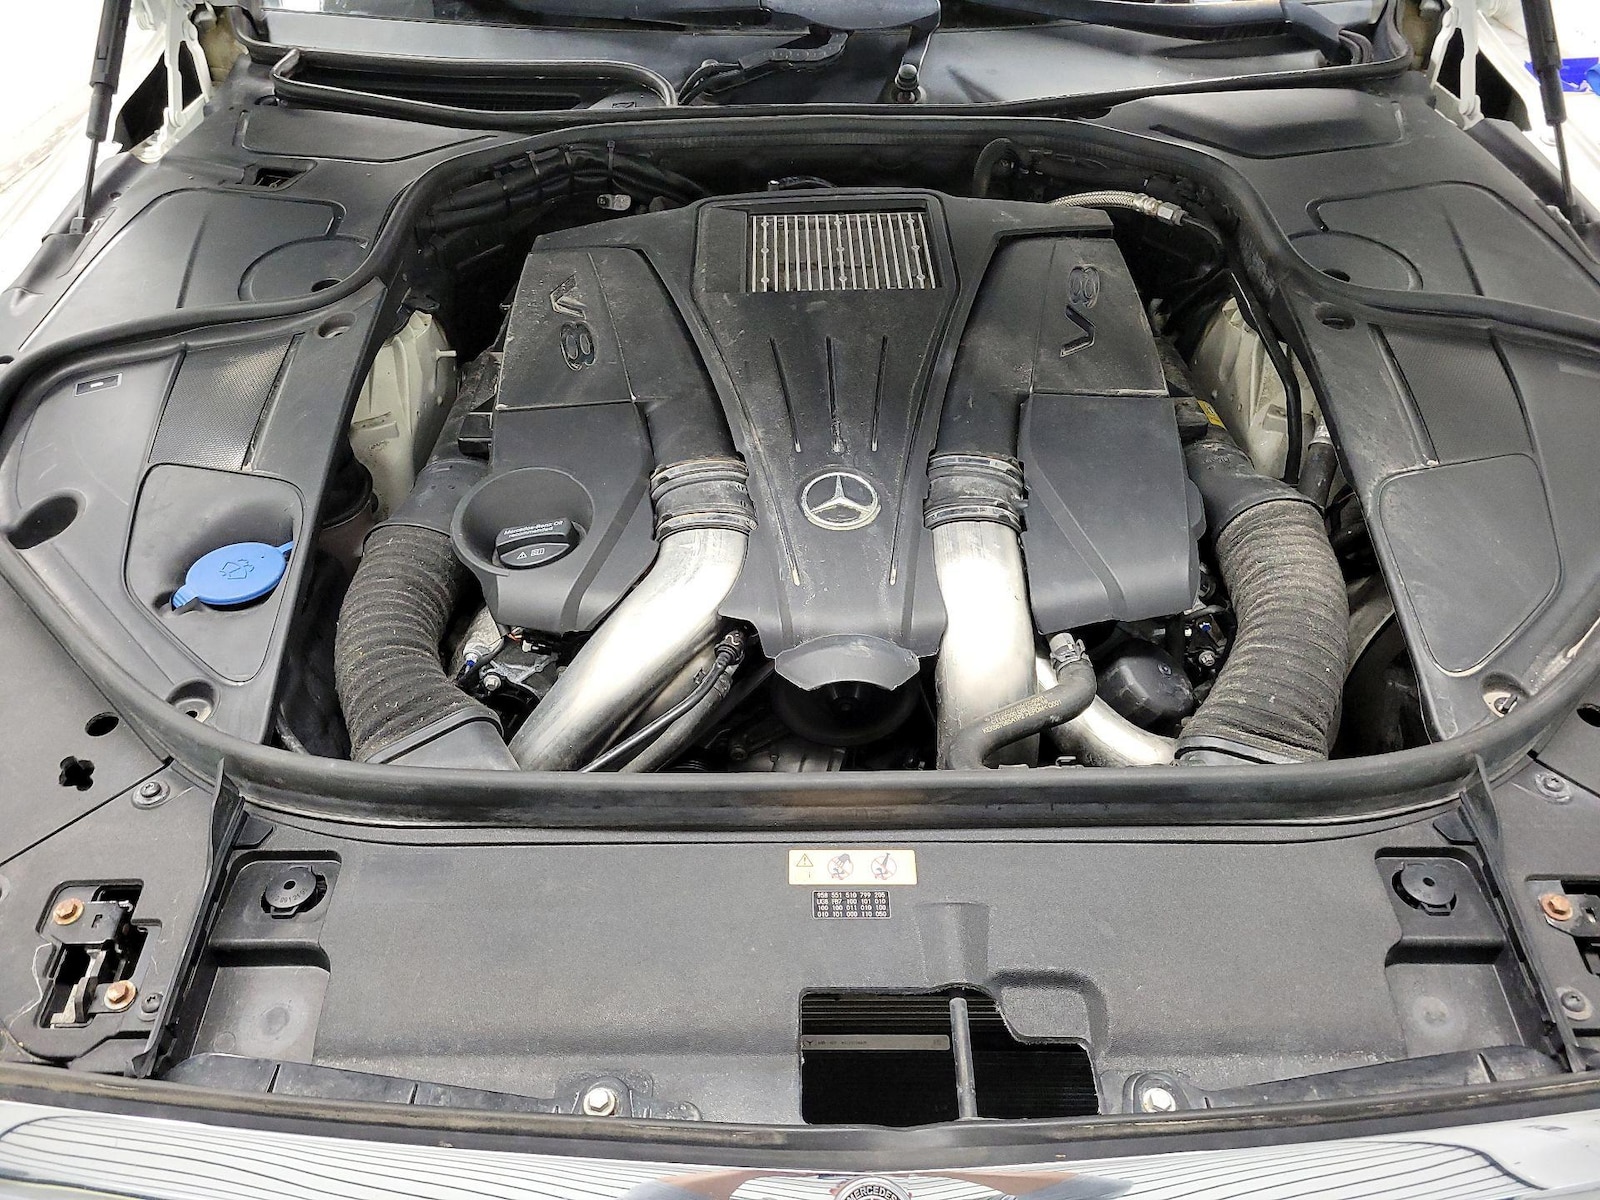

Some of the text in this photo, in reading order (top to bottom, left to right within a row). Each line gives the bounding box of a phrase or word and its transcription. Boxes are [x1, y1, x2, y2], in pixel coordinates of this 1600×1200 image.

[550, 270, 597, 370] V8
[1060, 265, 1100, 358] V8
[846, 1184, 899, 1200] MERCEDES
